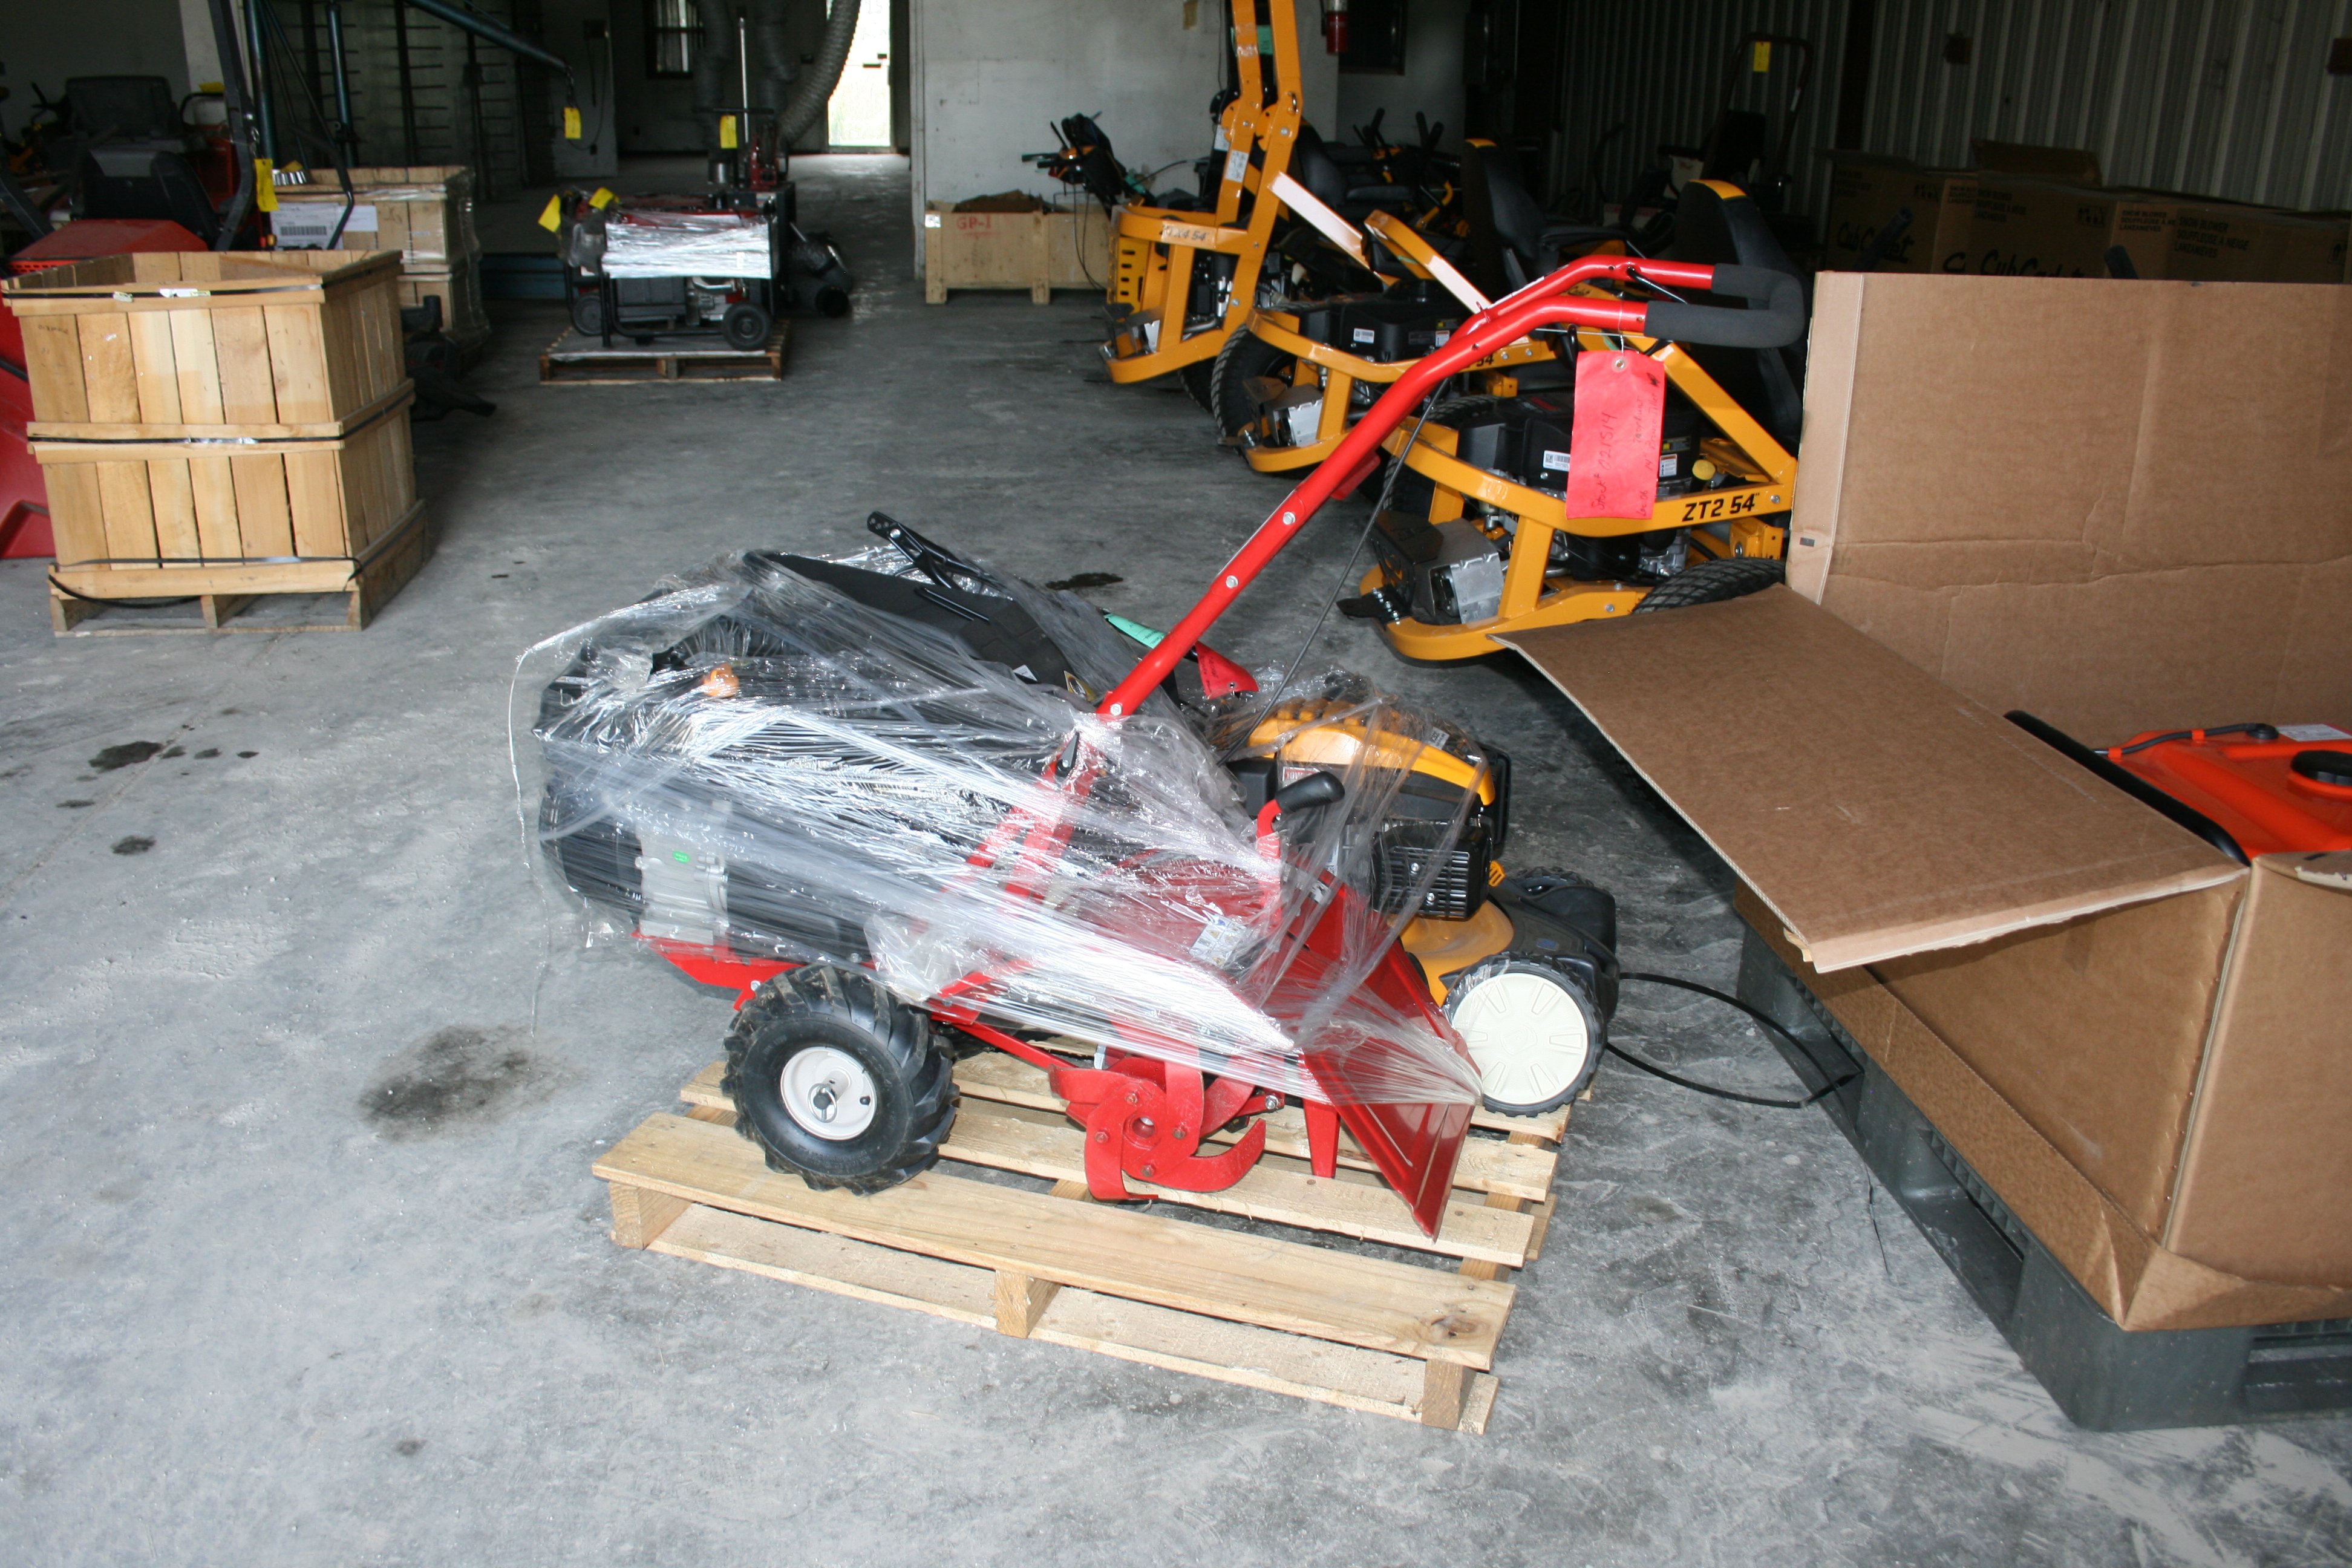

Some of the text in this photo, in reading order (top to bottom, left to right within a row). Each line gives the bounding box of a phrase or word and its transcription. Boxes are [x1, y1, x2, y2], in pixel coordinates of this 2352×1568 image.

[2179, 216, 2229, 232] SNOW BLOWER
[1860, 226, 1915, 264] Cet
[1598, 411, 1618, 470] 021514
[1682, 498, 1724, 522] ZT2
